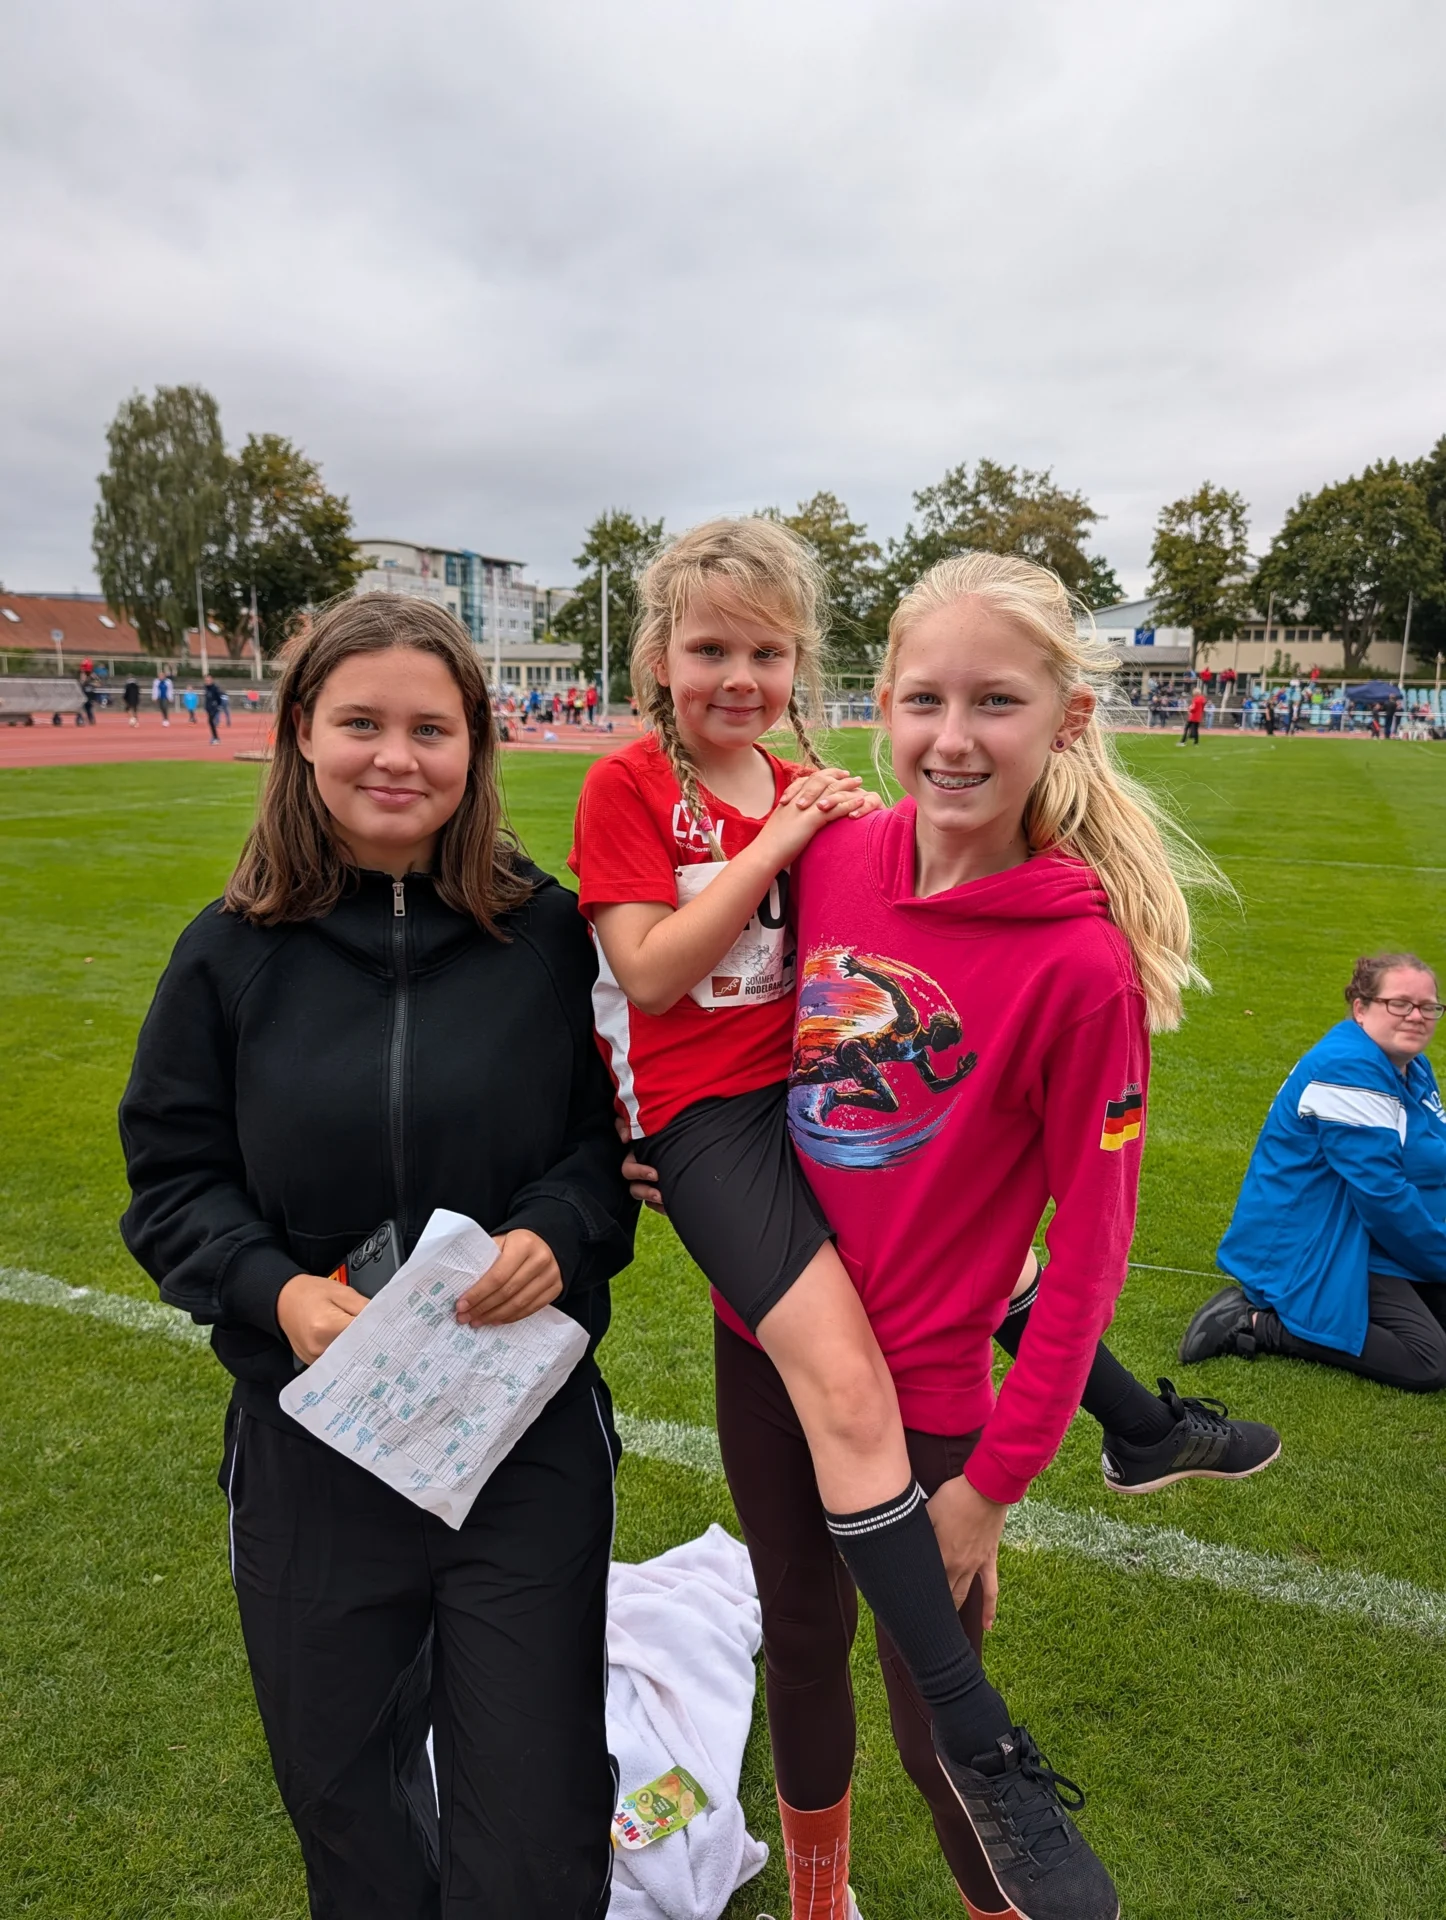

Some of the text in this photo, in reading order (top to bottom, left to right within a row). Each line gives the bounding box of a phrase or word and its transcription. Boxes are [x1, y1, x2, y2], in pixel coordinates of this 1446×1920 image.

[743, 869, 790, 930] 0
[745, 974, 774, 986] SOMMER
[745, 981, 783, 995] RODELBAH
[613, 1811, 640, 1842] HiPP
